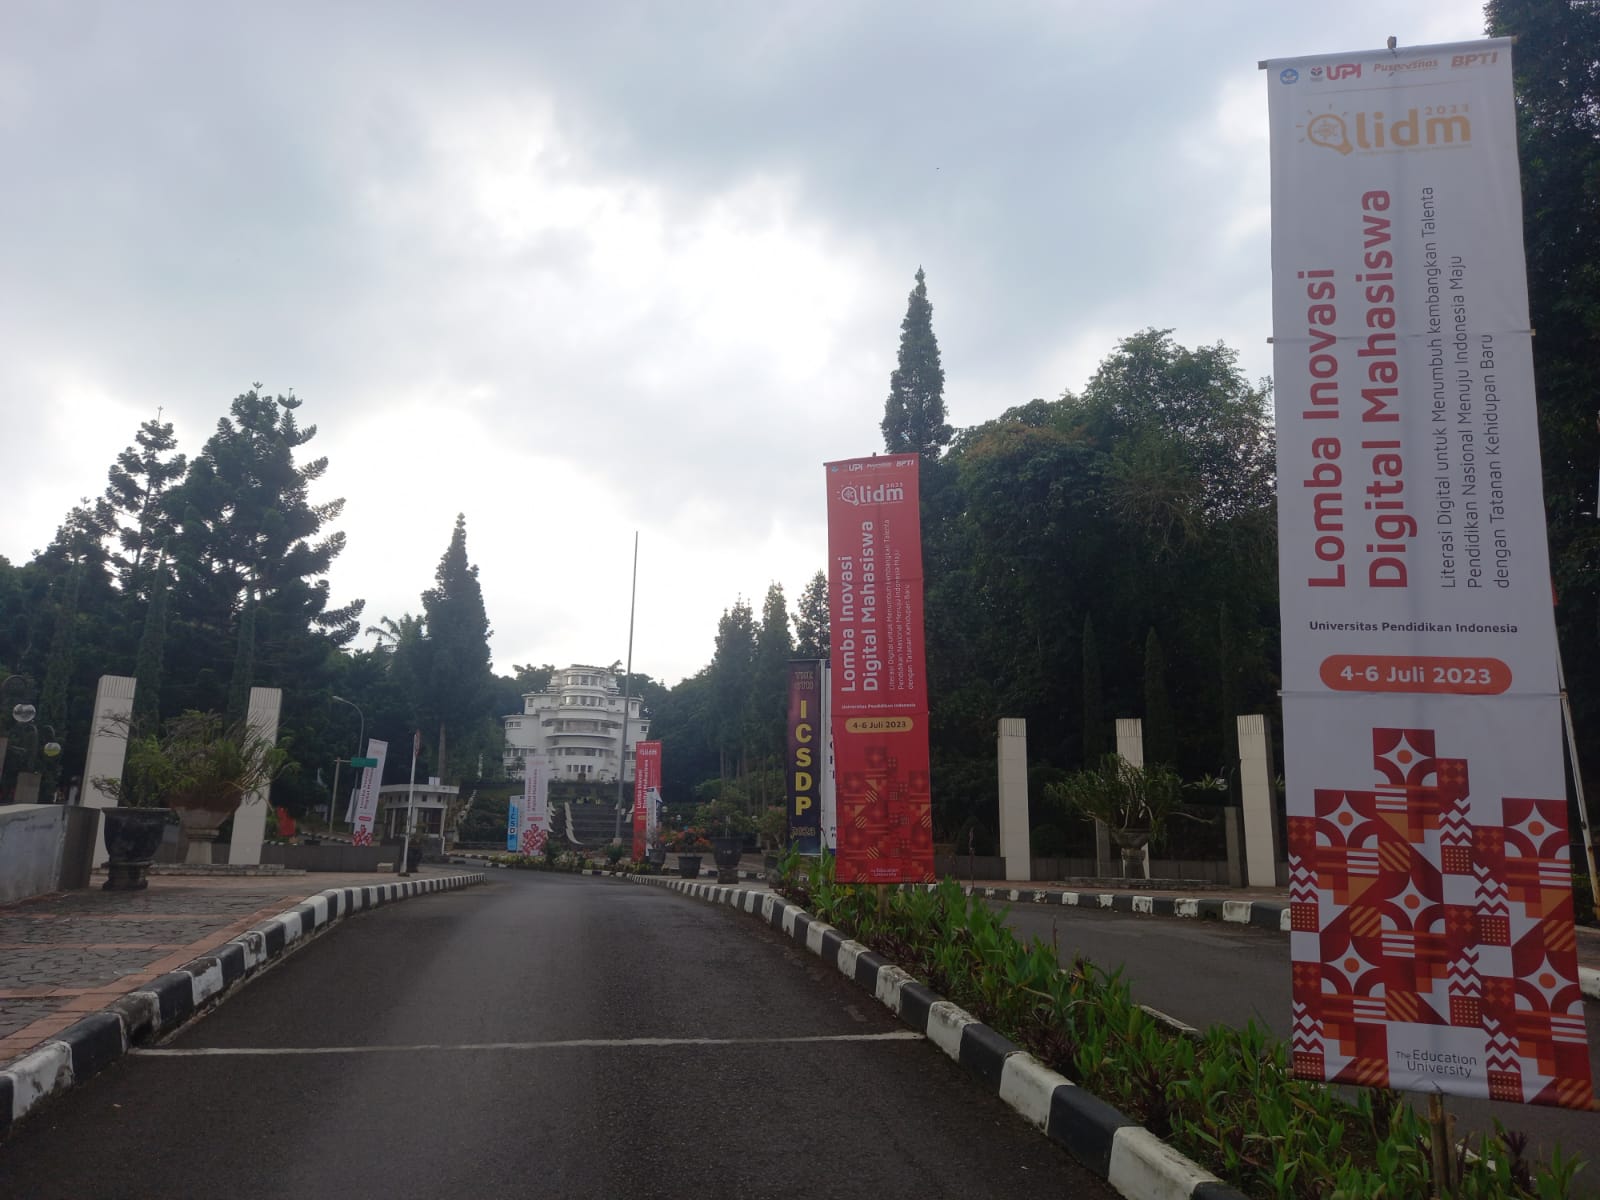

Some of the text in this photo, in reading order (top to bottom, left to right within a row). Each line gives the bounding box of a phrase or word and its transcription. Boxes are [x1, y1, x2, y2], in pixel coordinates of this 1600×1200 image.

[1325, 64, 1362, 80] UPI
[1451, 52, 1498, 68] BPTI
[1355, 108, 1472, 149] lidm
[1355, 190, 1418, 588] Digital Mahasiswa
[1420, 187, 1456, 588] Literasi Digital untuk Menumbuh kembangkan Talenta
[1448, 255, 1482, 588] Pendidikan Nasional Menuju Indonesia Maju
[1297, 269, 1346, 587] Lomba Inovasi
[1480, 334, 1512, 589] dengan Tatanan Kehidupan Baru
[860, 484, 904, 503] lidm
[837, 556, 856, 692] Lomba Inovasi
[859, 521, 882, 691] Digital Mahasiswa
[1309, 620, 1519, 634] Universitas Pendidikan Indonesia
[1340, 665, 1492, 684] 4-6 Juli 2023
[795, 700, 813, 816] ICSDP
[886, 720, 906, 728] 2023
[1406, 1060, 1472, 1079] University
[1412, 1049, 1478, 1066] Education
